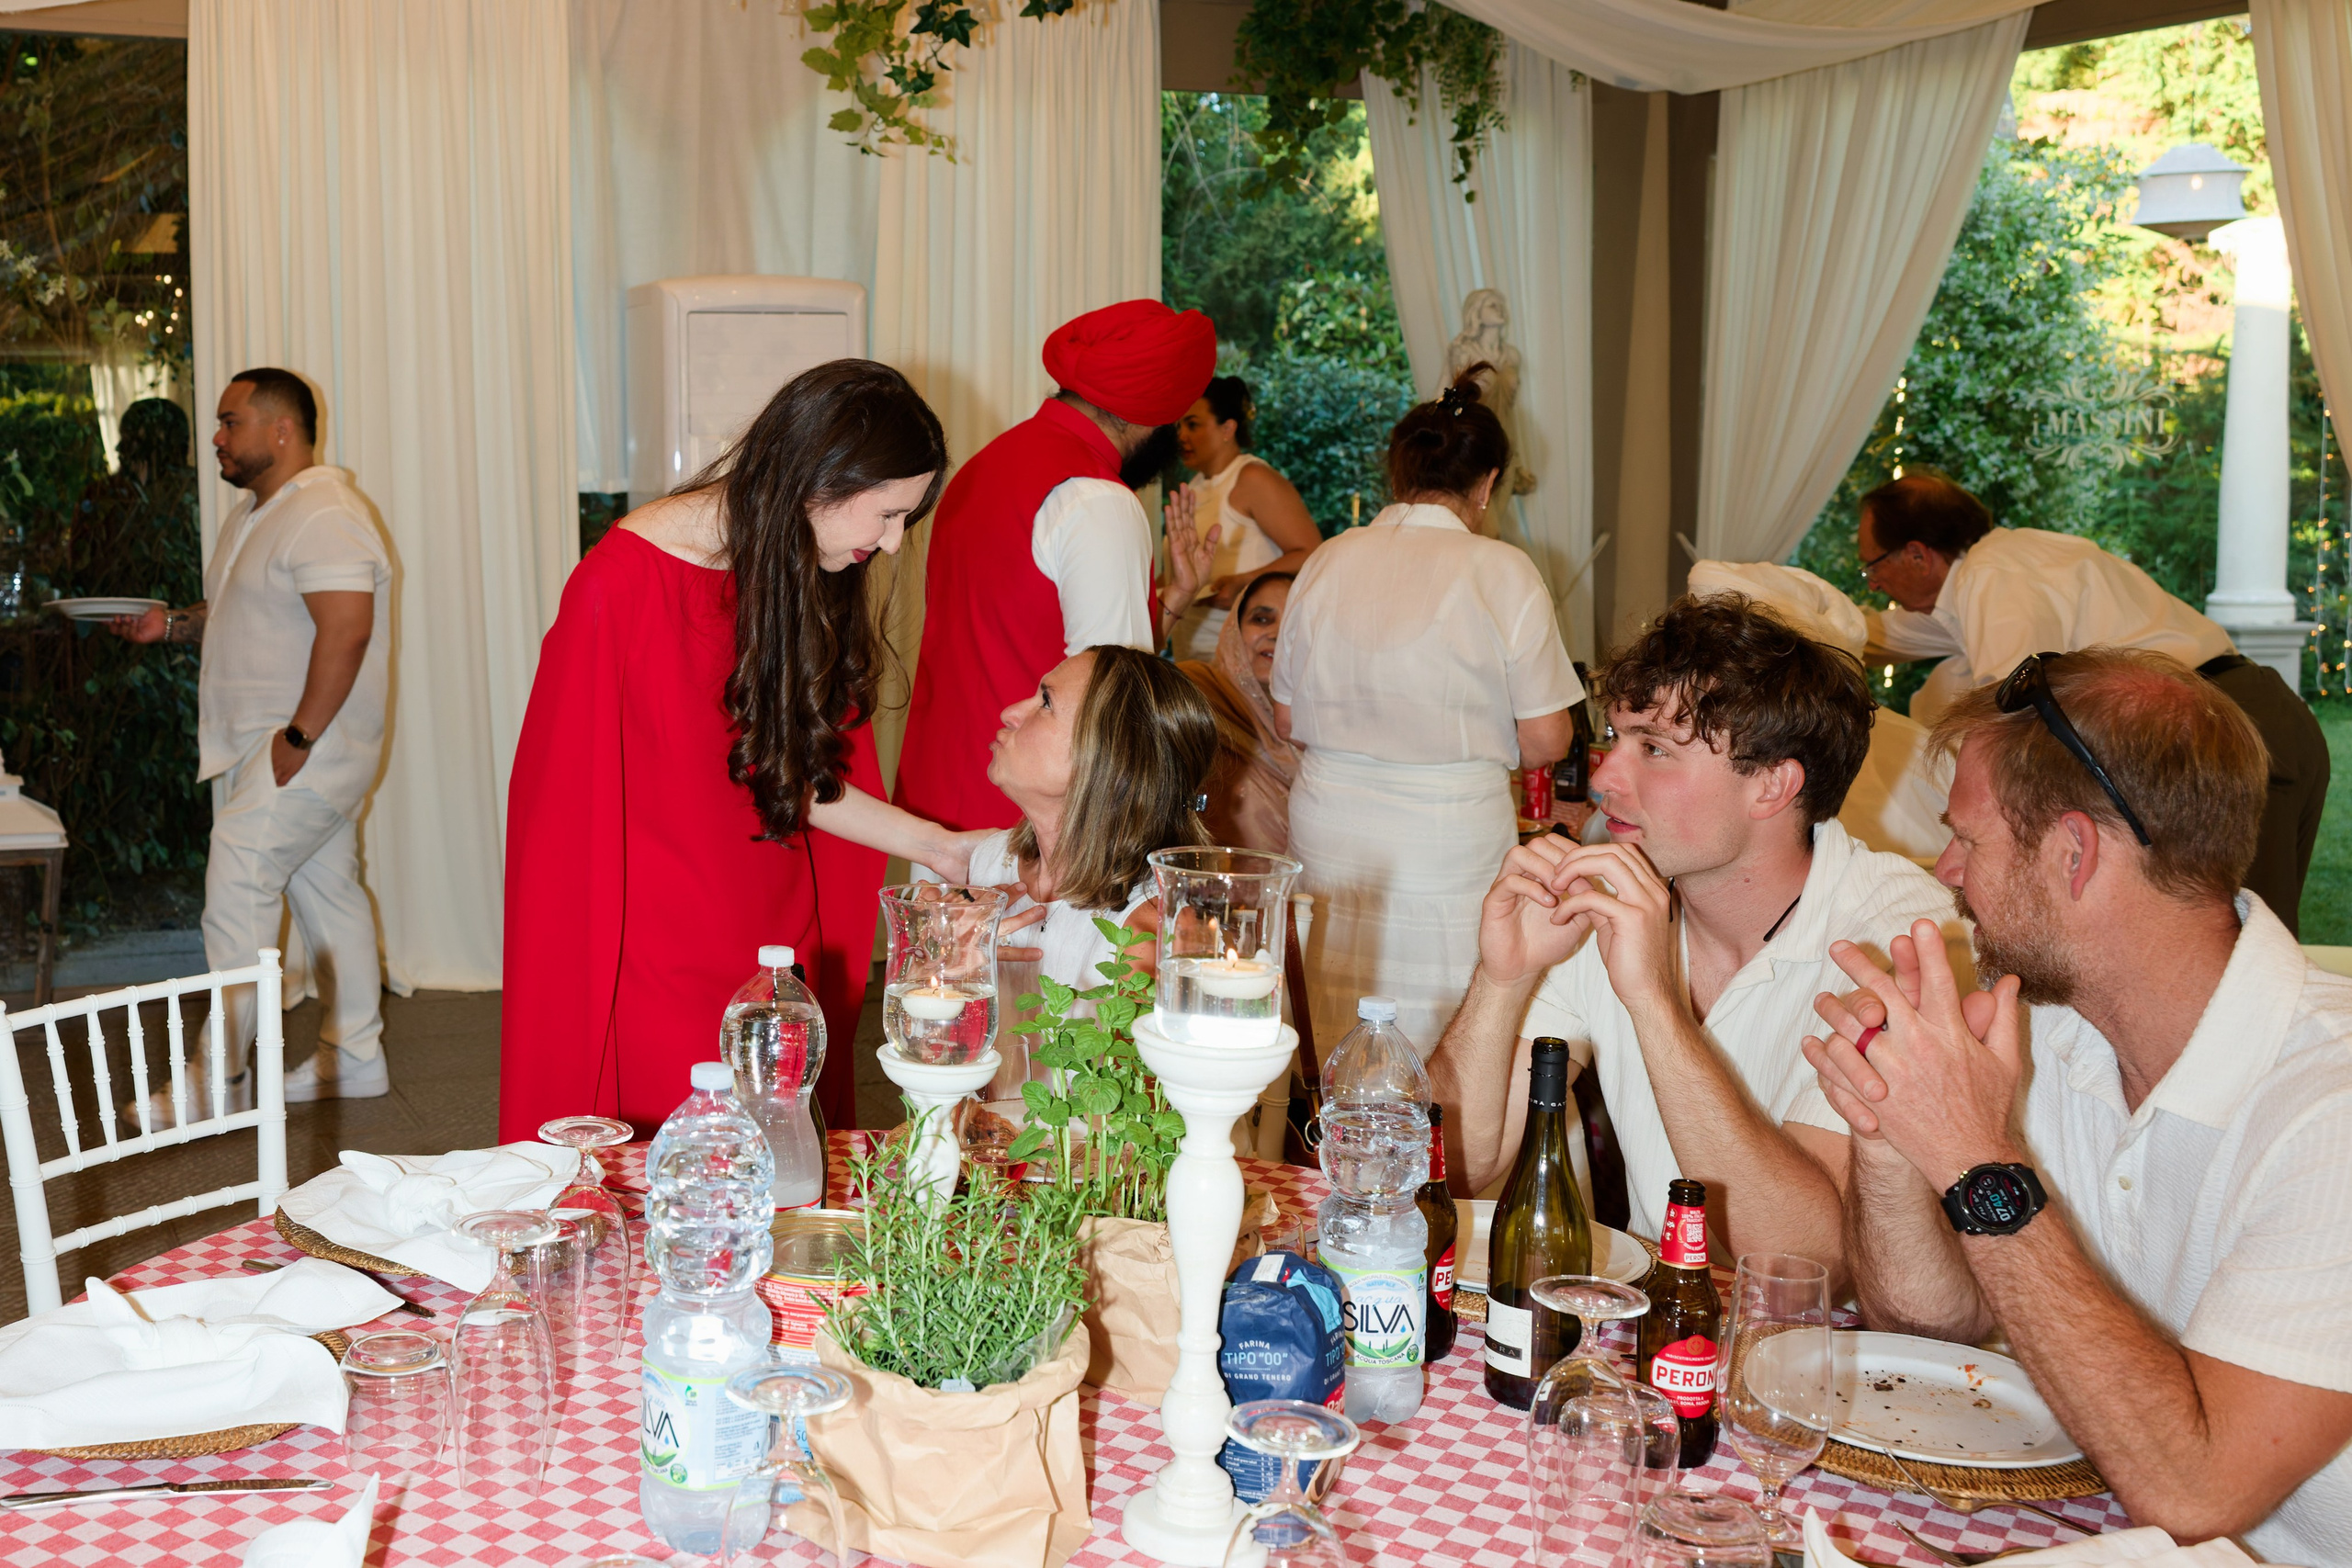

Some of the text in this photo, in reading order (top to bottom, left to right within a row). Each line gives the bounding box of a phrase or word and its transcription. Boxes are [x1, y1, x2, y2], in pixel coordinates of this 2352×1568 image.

[2049, 407, 2166, 436] MASSINI
[1342, 1301, 1415, 1334] SILVA
[1238, 1340, 1270, 1350] FARINA
[1225, 1351, 1256, 1365] TIPO
[1355, 1352, 1405, 1365] ACQUA TOSCANA
[1234, 1372, 1259, 1381] GRANO
